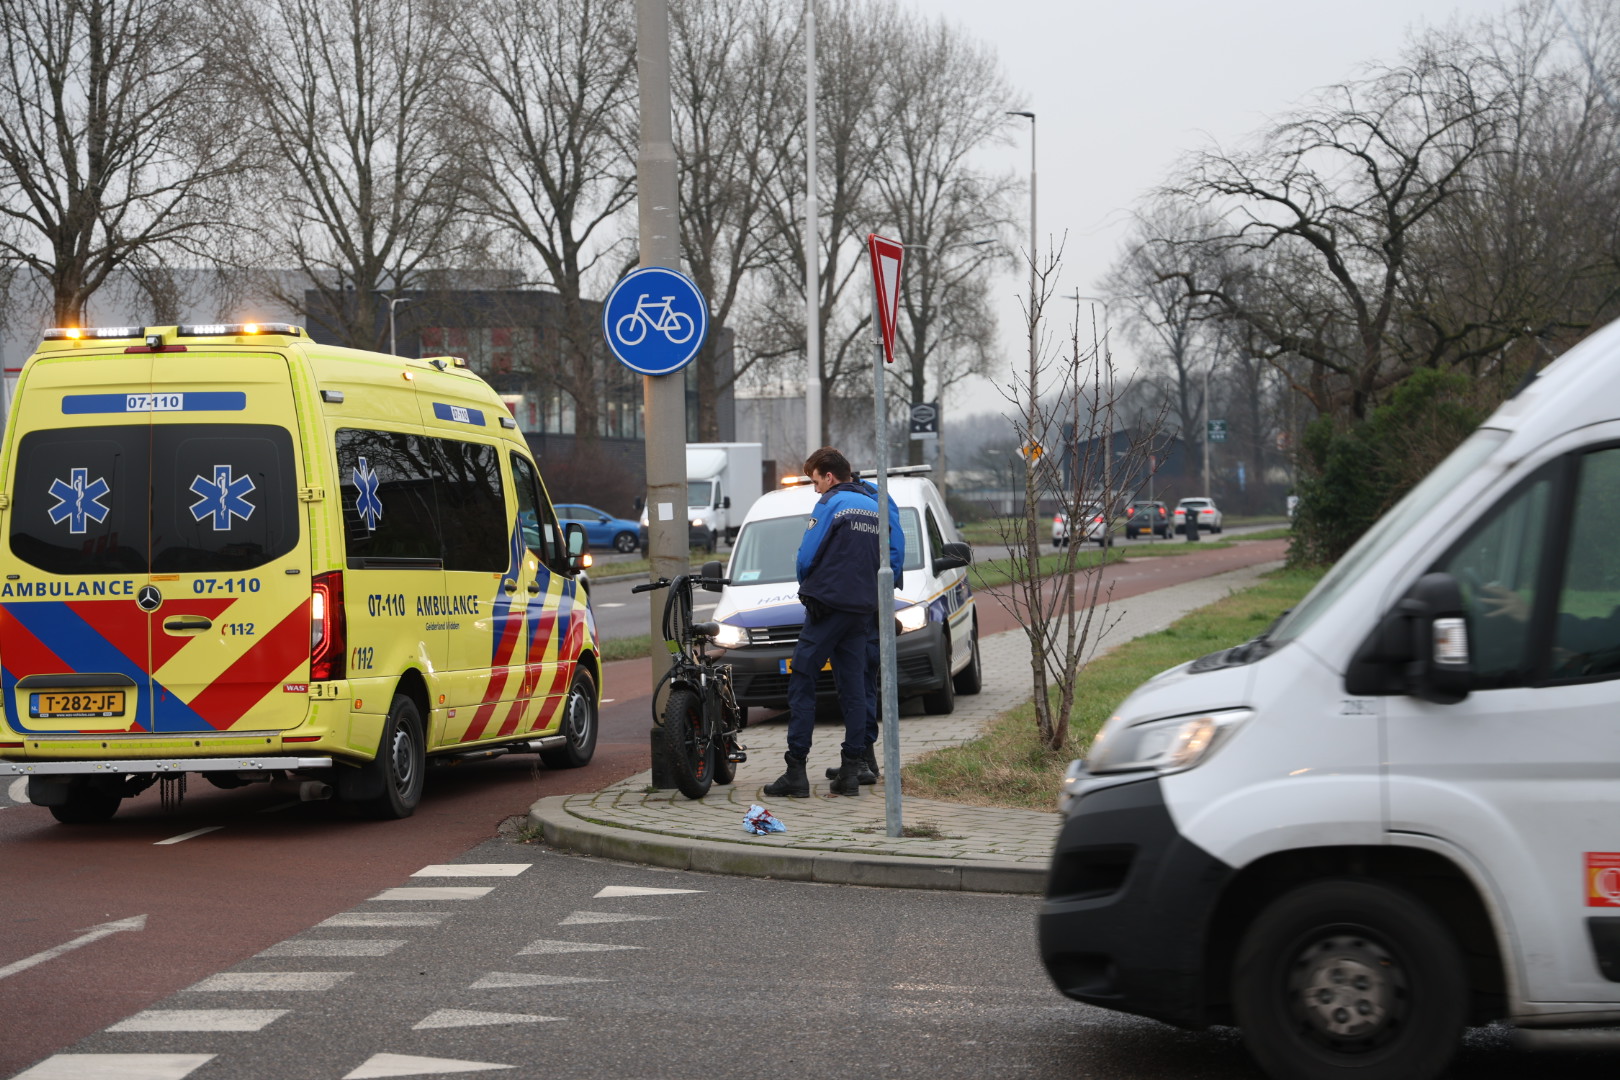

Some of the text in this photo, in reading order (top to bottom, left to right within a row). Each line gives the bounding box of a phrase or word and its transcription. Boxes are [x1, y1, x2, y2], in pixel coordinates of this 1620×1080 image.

[128, 396, 179, 409] 07-110
[1, 580, 134, 597] AMBULANCE
[193, 578, 261, 594] 07-110
[368, 594, 480, 617] 07-110 AMBULANCE
[757, 593, 800, 605] HAN
[46, 695, 116, 711] T-282-JF
